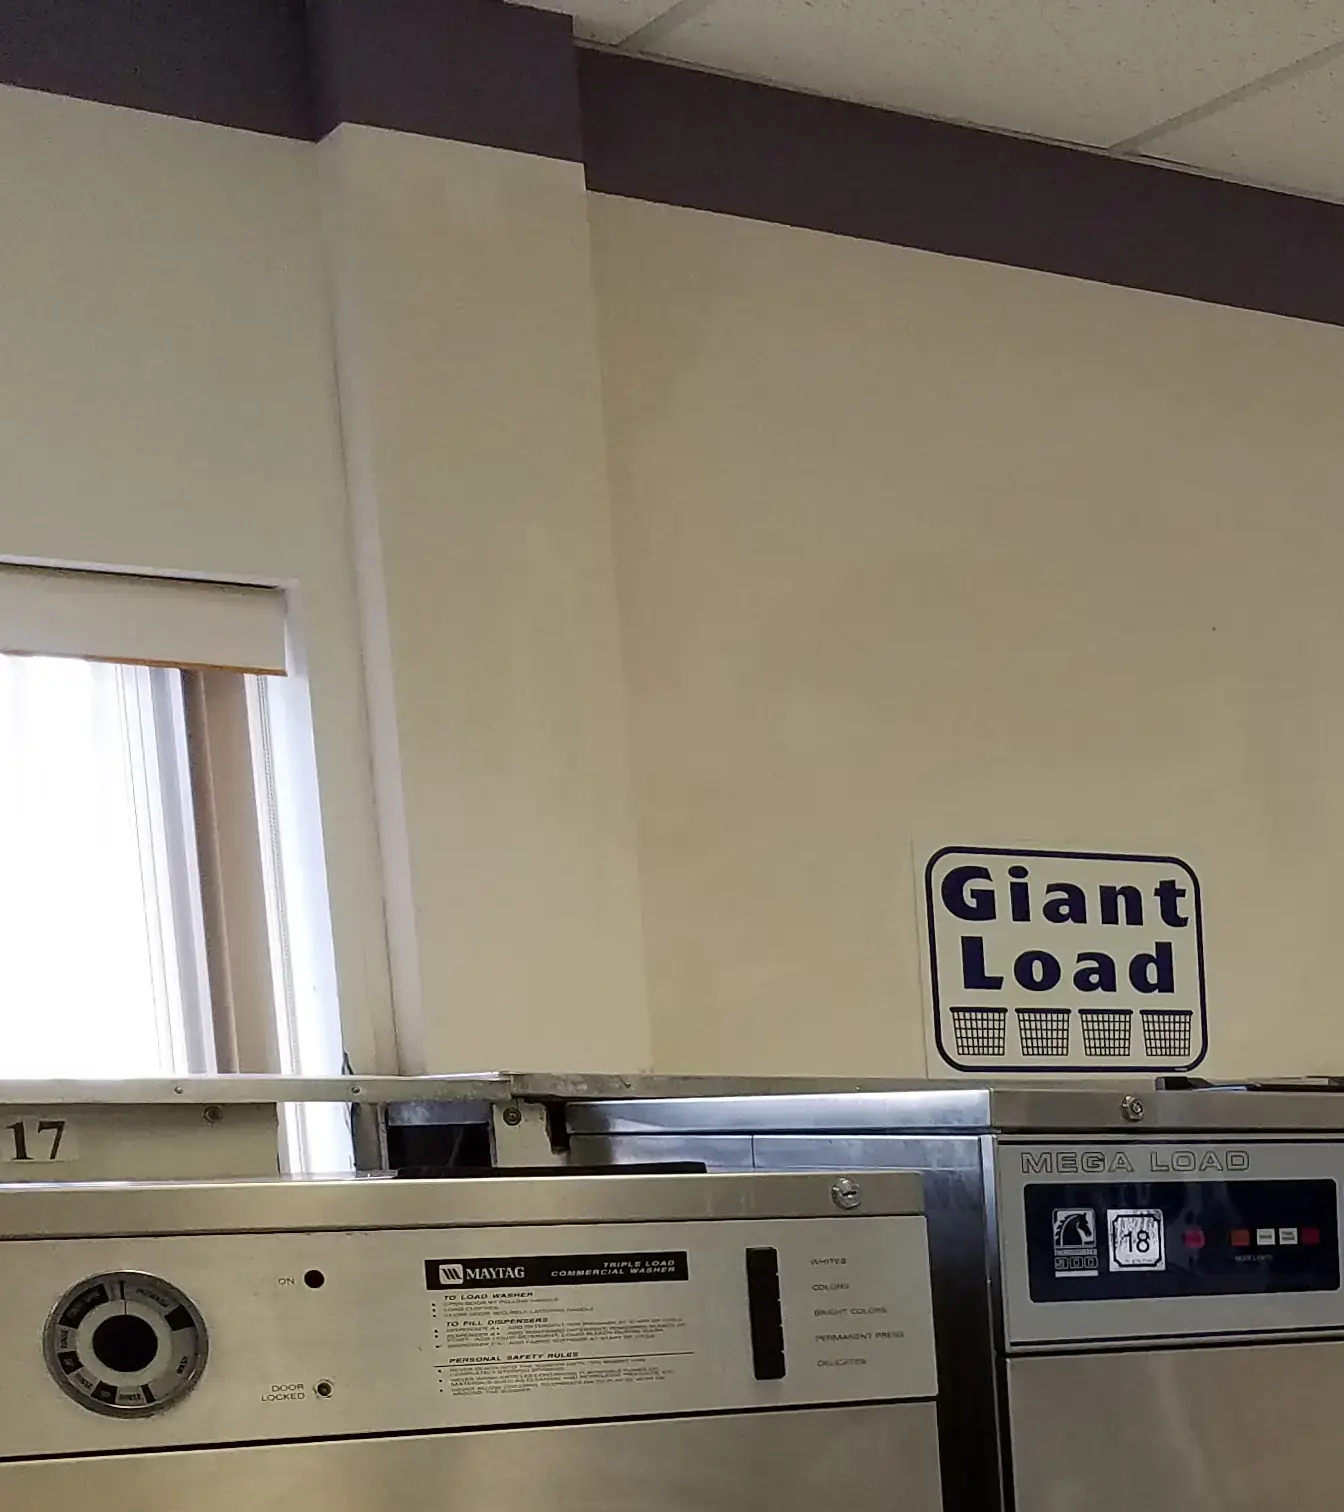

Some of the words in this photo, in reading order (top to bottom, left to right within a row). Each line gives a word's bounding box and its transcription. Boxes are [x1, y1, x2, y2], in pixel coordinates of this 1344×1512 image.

[940, 865, 1190, 928] Giant
[961, 936, 1176, 994] Load
[5, 1119, 66, 1161] 17
[1021, 1151, 1135, 1174] MEGA
[1150, 1150, 1251, 1172] LOAD
[1124, 1230, 1151, 1254] 18
[465, 1266, 526, 1280] MAYTAG
[551, 1268, 625, 1277] COMMERCIAL
[629, 1266, 676, 1274] WASHER
[461, 1293, 489, 1301] LOAD
[261, 1392, 306, 1402] LOCKED
[271, 1383, 305, 1392] DOOR
